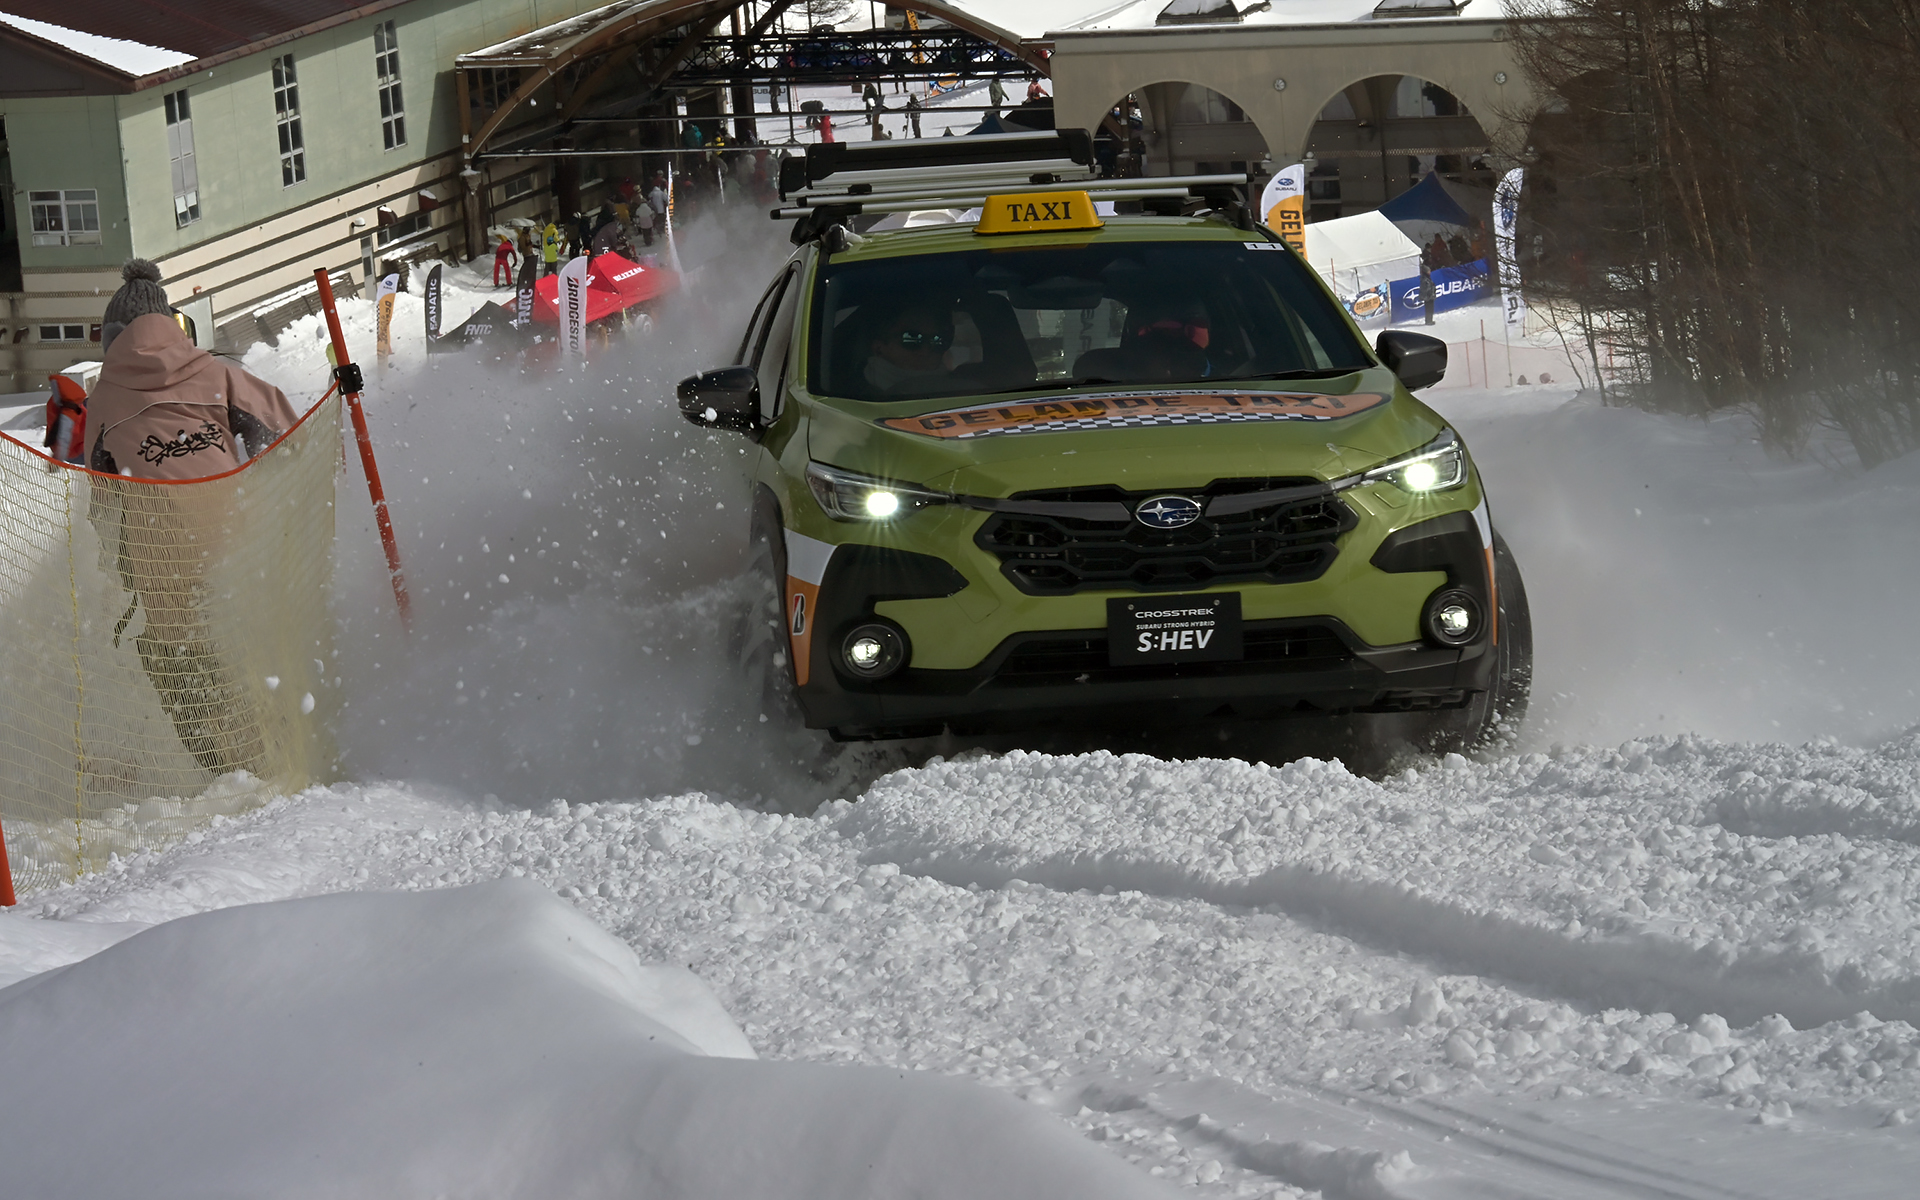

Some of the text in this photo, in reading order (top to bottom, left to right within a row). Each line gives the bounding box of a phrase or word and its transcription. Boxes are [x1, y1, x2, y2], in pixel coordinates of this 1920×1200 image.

[1007, 201, 1072, 222] TAXI
[429, 278, 438, 331] FANATIC
[518, 288, 534, 325] FNTC
[464, 323, 493, 336] FNTC
[1211, 395, 1346, 410] TAXI
[1135, 608, 1215, 619] CROSSTREK
[1163, 621, 1189, 629] STRONG
[1136, 629, 1215, 653] S:HEV
